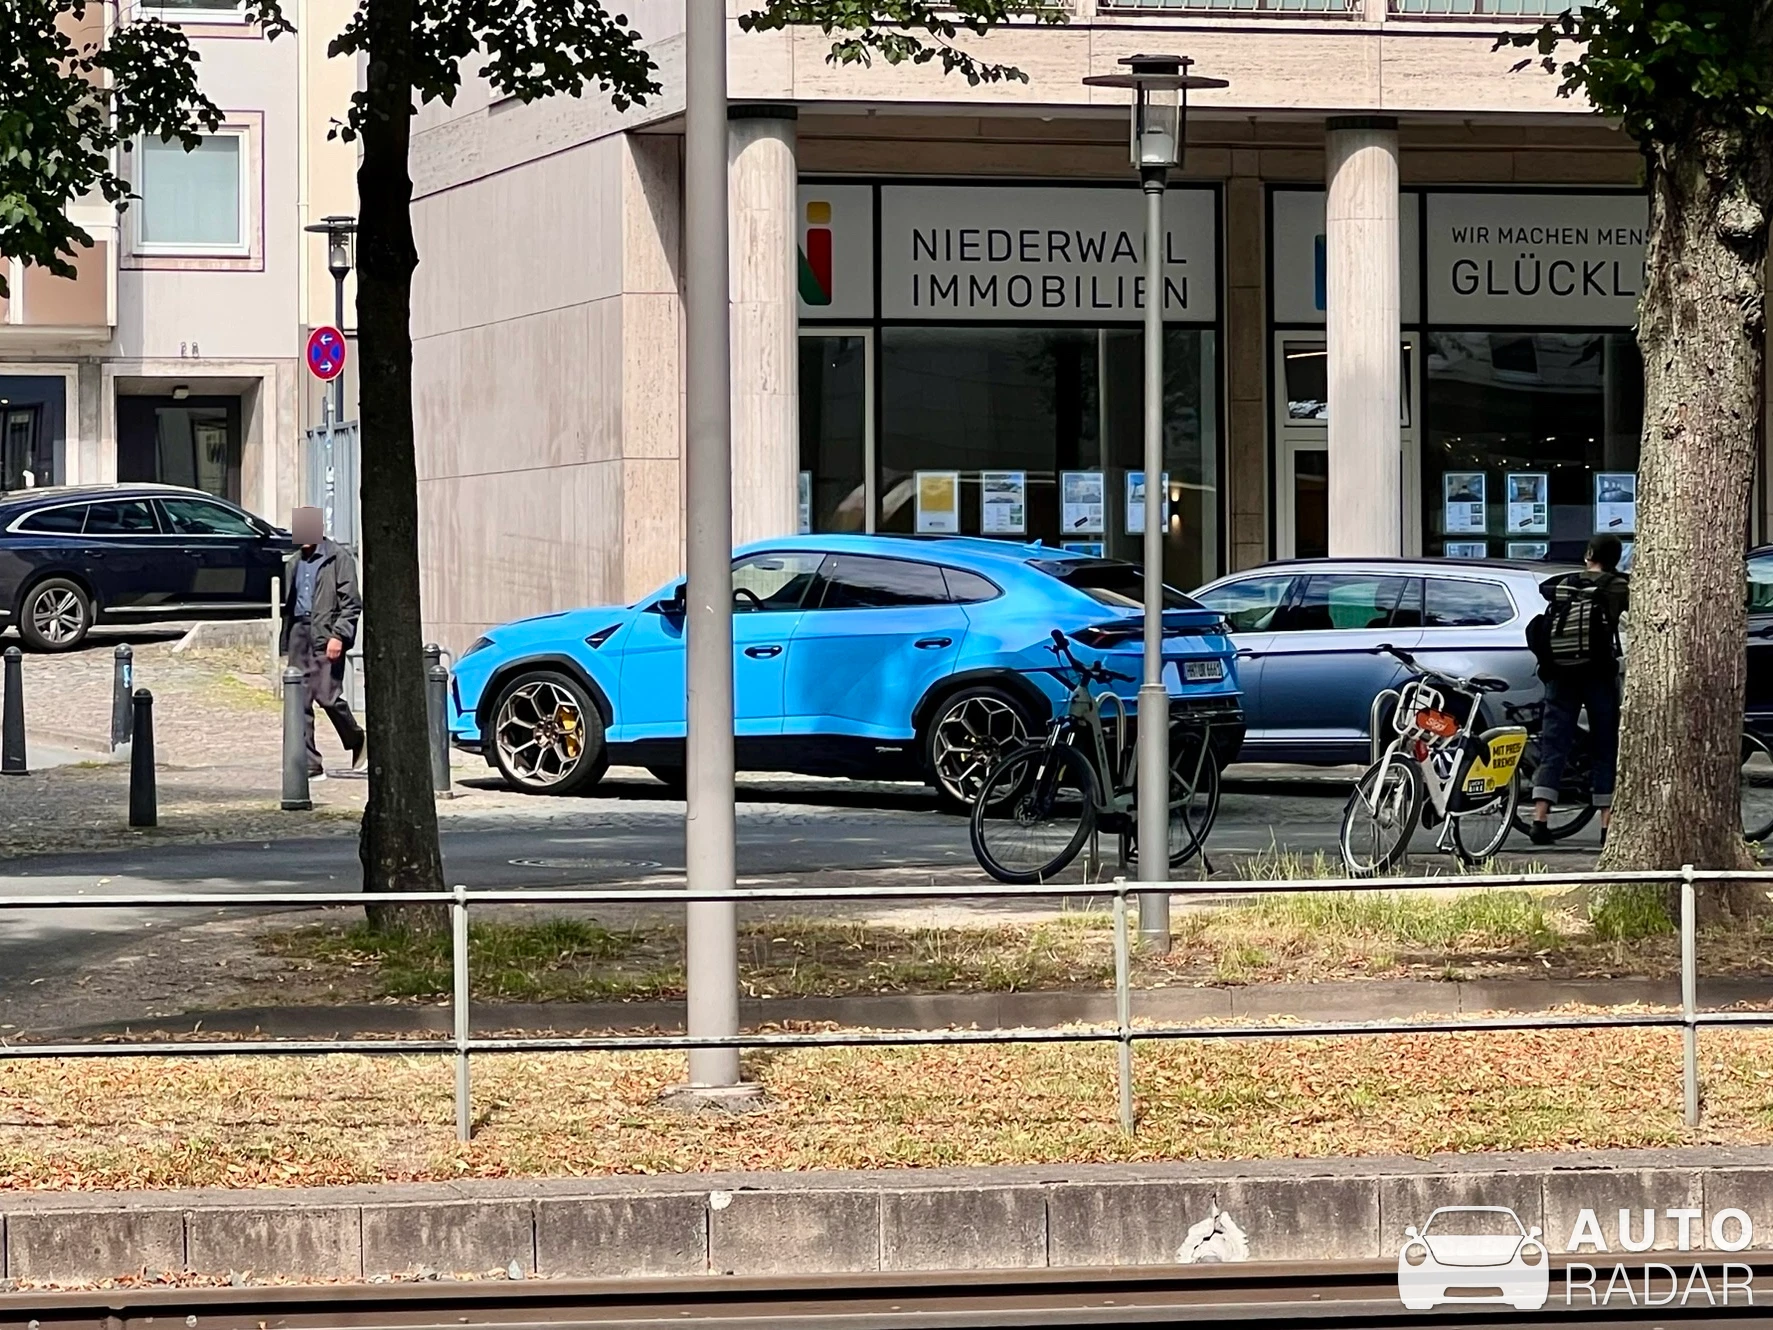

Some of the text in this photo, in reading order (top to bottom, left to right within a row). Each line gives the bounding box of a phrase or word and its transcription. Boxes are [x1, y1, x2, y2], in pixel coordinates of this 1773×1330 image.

[912, 228, 1187, 264] NIEDERWAL
[1451, 226, 1490, 244] WIR
[1498, 227, 1589, 245] MACHEN
[912, 274, 1188, 310] IMMOBILIEN
